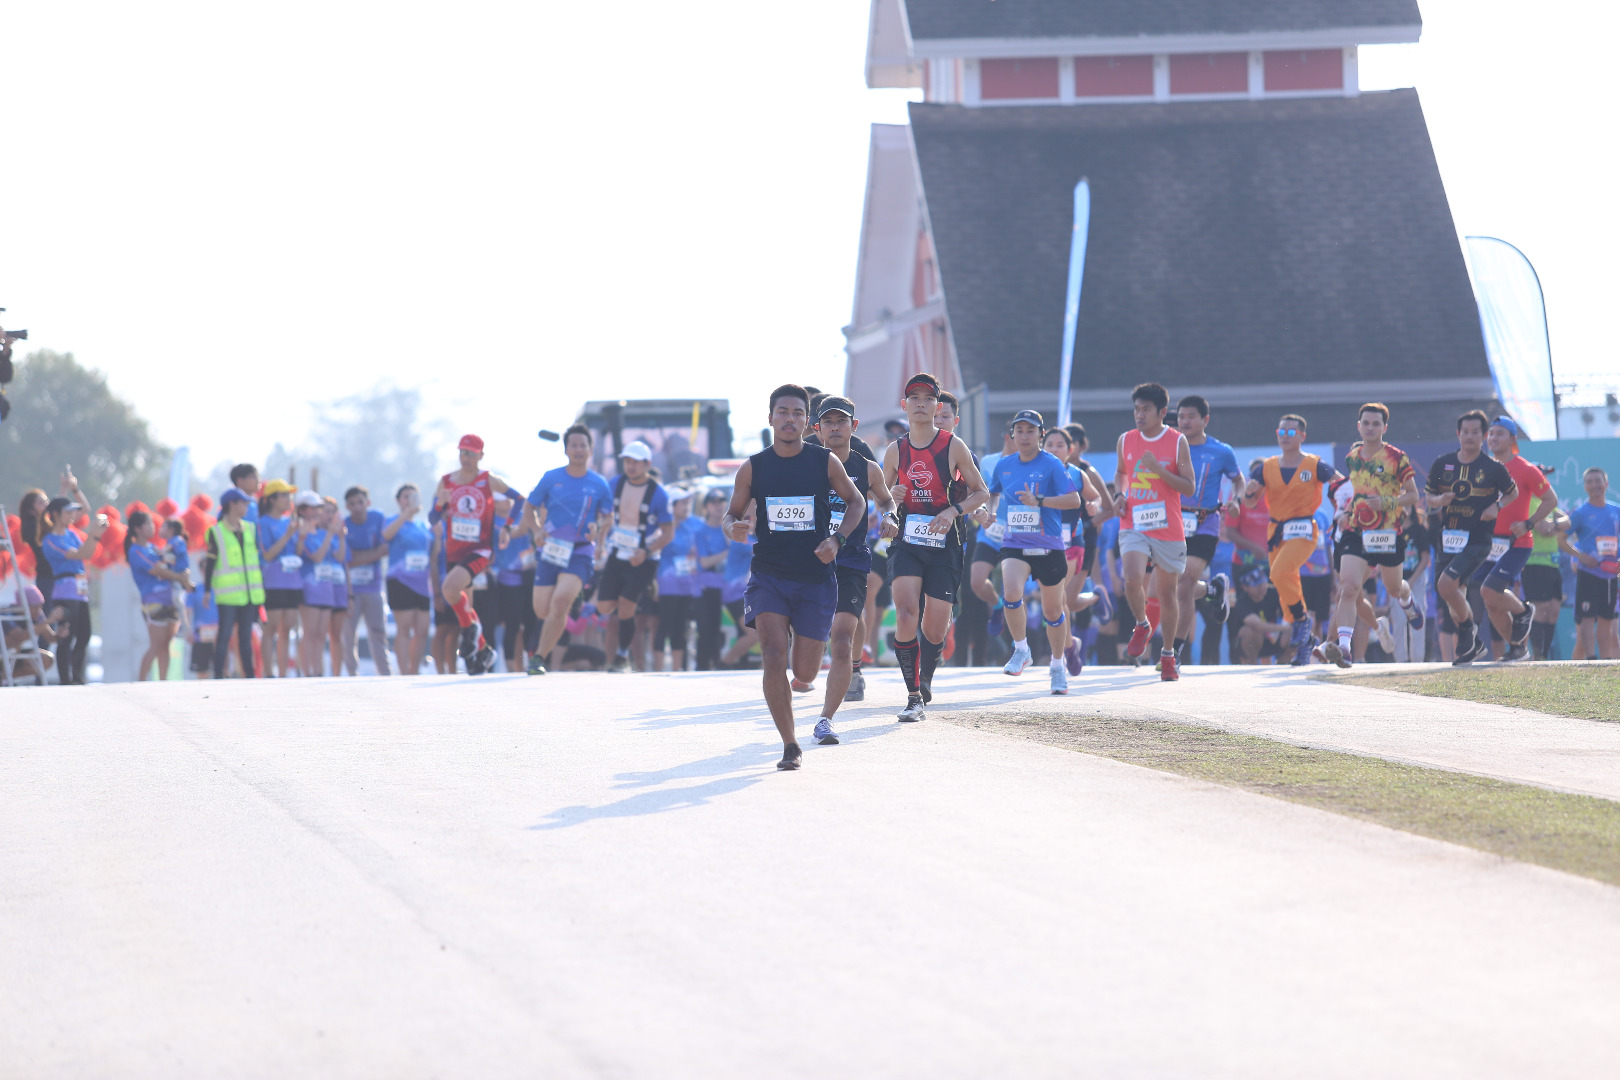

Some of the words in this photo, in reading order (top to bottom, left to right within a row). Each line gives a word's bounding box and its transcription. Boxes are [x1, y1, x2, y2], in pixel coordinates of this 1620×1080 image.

[777, 507, 806, 519] 6396
[1141, 511, 1159, 520] 6309
[1012, 514, 1034, 523] 6056
[1370, 535, 1389, 543] 6300
[1445, 536, 1463, 545] 6077
